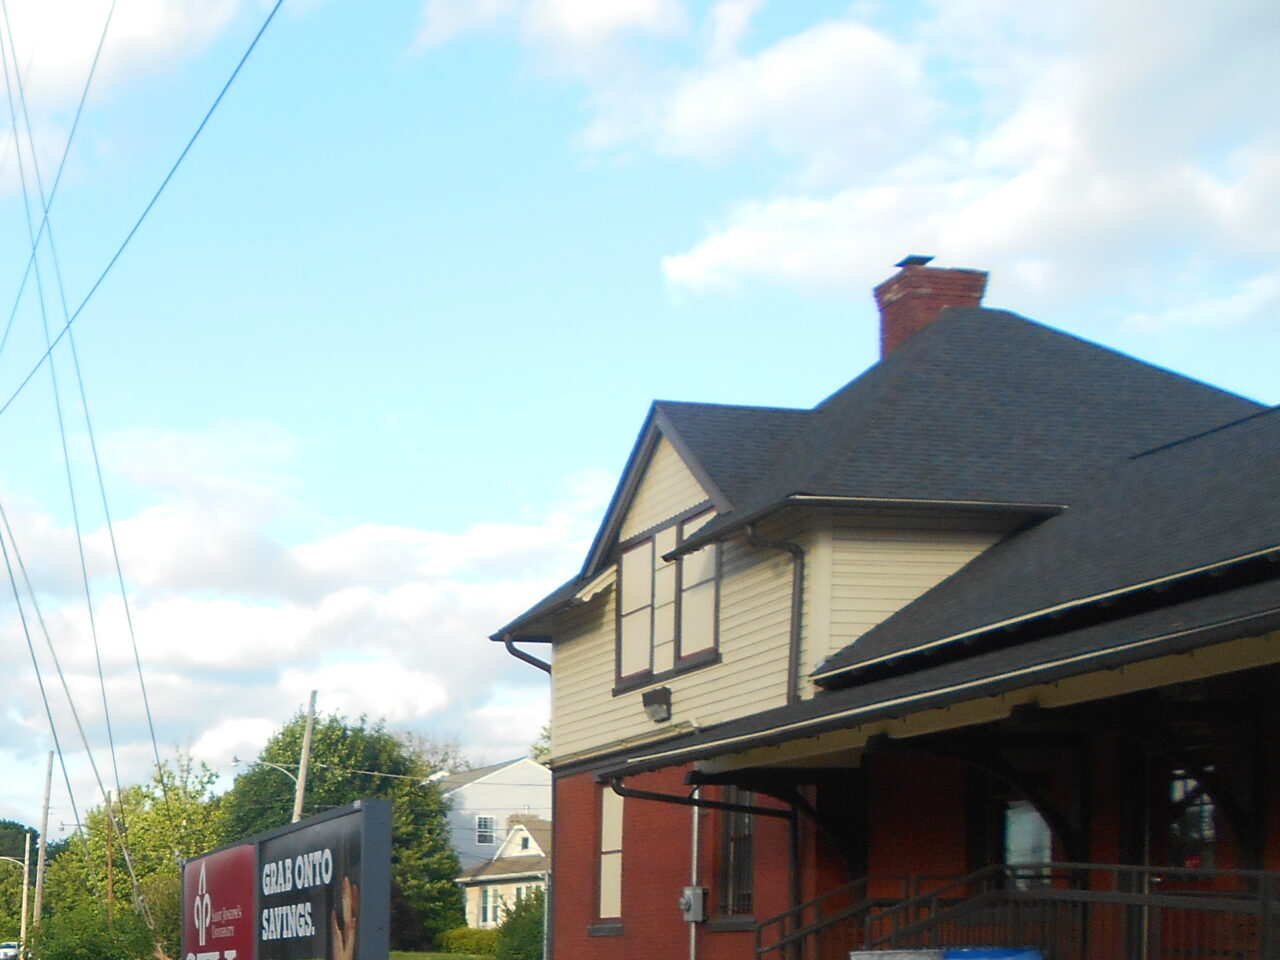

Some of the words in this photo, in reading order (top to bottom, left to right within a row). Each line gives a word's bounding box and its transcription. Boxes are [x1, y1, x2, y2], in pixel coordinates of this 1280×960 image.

[262, 858, 293, 896] GRAB
[294, 848, 333, 890] ONTO
[262, 902, 315, 940] SAVINGS.
